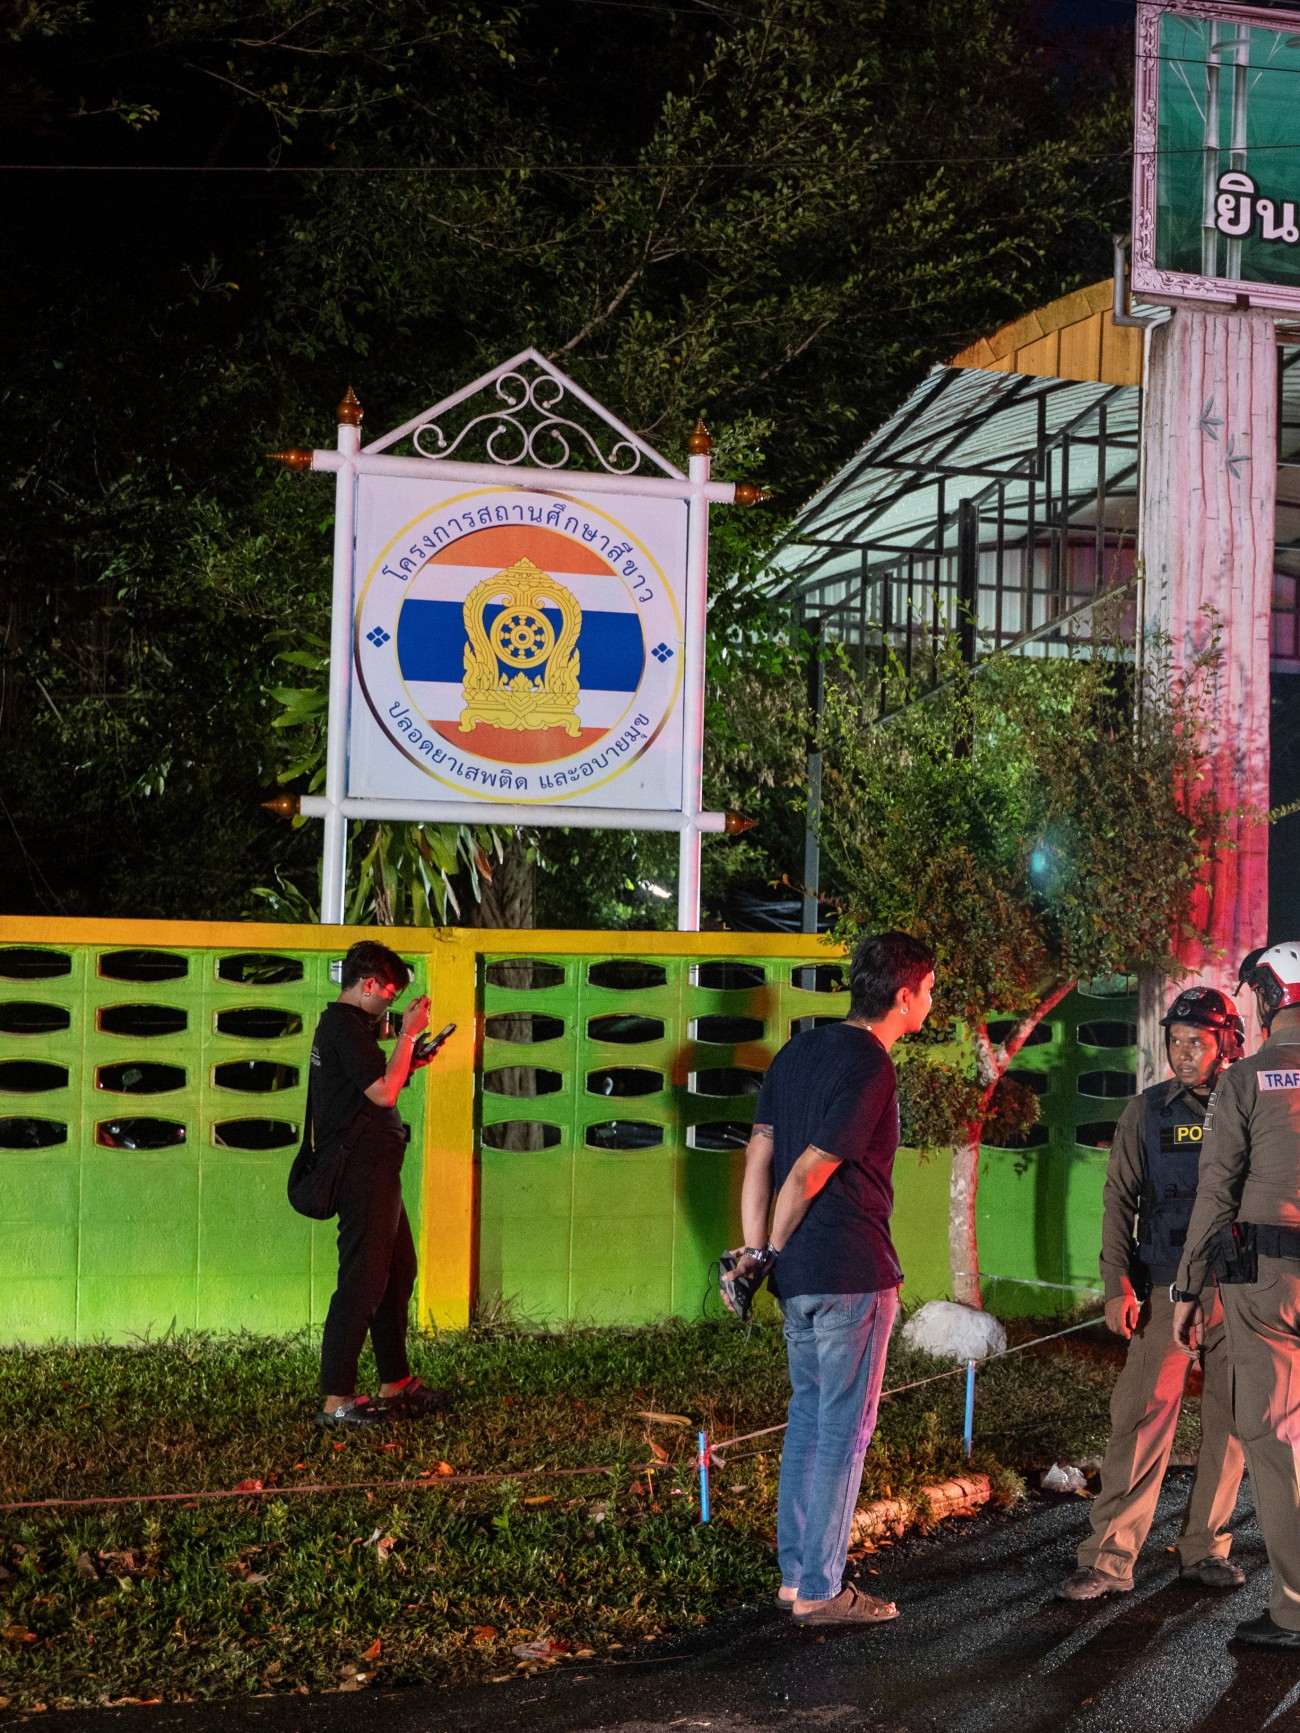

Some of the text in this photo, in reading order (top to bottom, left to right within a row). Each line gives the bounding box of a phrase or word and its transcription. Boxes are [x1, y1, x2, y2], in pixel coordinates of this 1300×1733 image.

[381, 503, 654, 604] โครงการสถานศึกษาสีขาว
[388, 700, 651, 790] ปลอดยาเสพติด และอบายมุข
